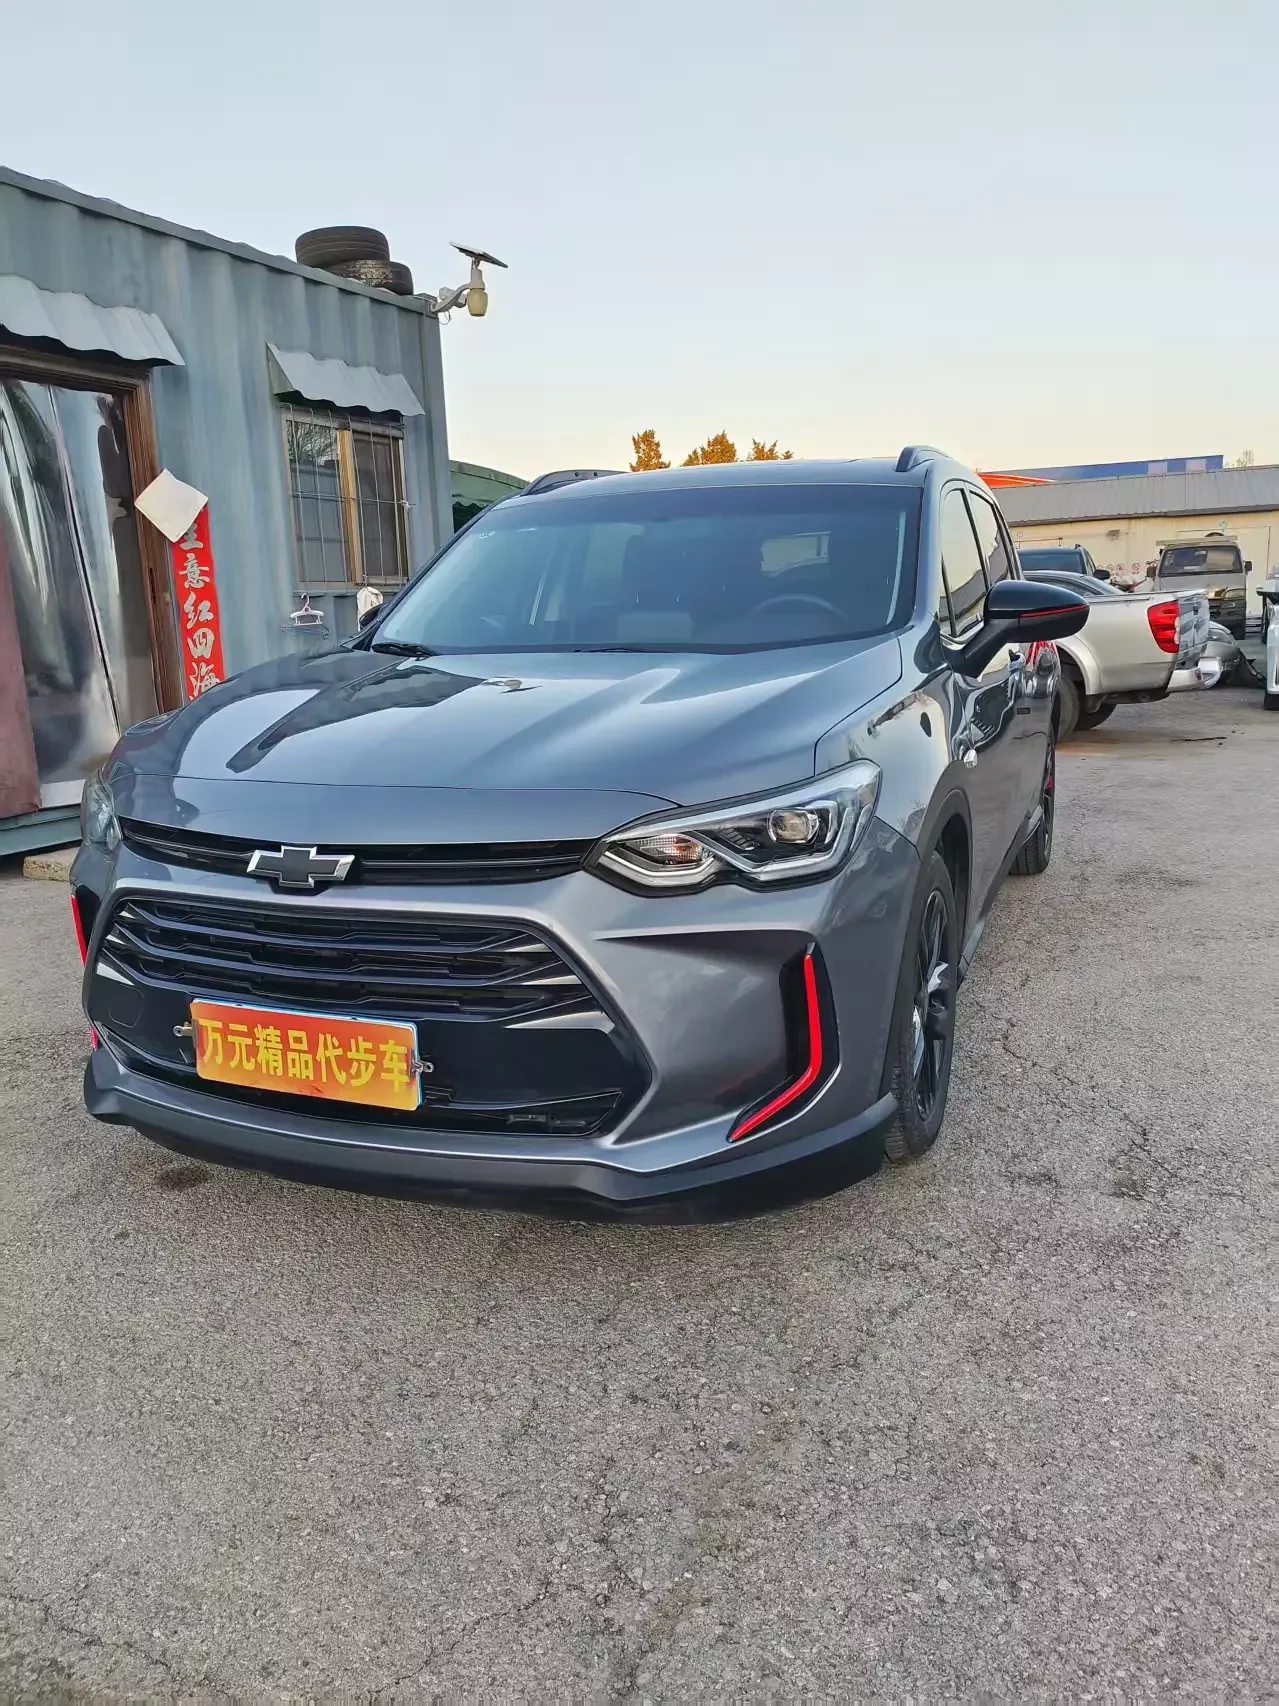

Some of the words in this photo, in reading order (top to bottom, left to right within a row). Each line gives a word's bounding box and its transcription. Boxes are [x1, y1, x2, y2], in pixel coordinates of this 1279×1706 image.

[198, 1017, 411, 1093] 万元精品代步车
